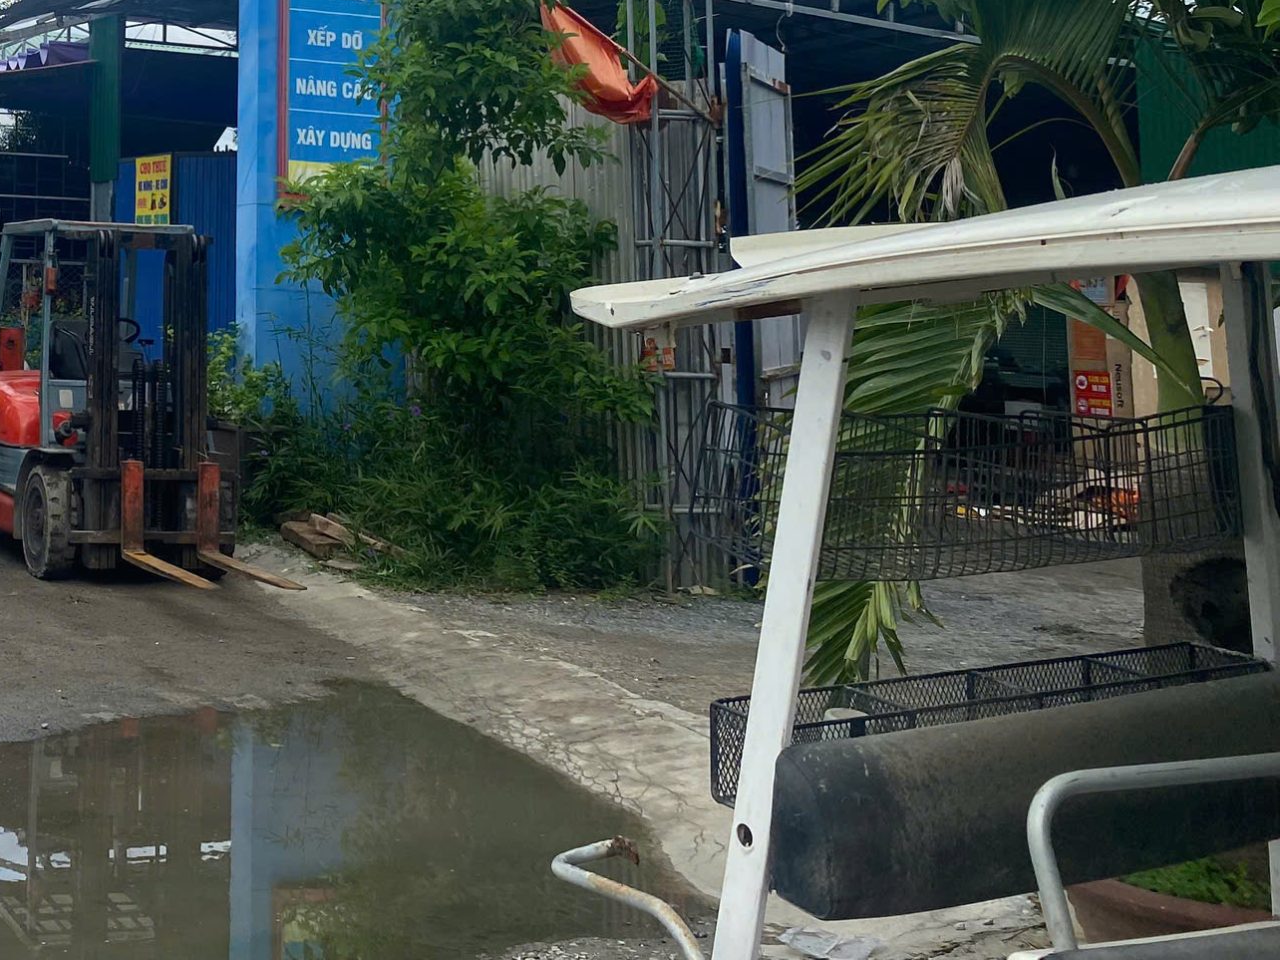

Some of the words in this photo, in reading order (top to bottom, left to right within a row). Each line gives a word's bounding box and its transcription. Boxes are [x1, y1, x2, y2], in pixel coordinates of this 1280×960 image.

[307, 24, 337, 48] XẾP
[295, 75, 337, 98] NÂNG
[296, 125, 326, 147] XÂY
[329, 129, 372, 153] DỰNG
